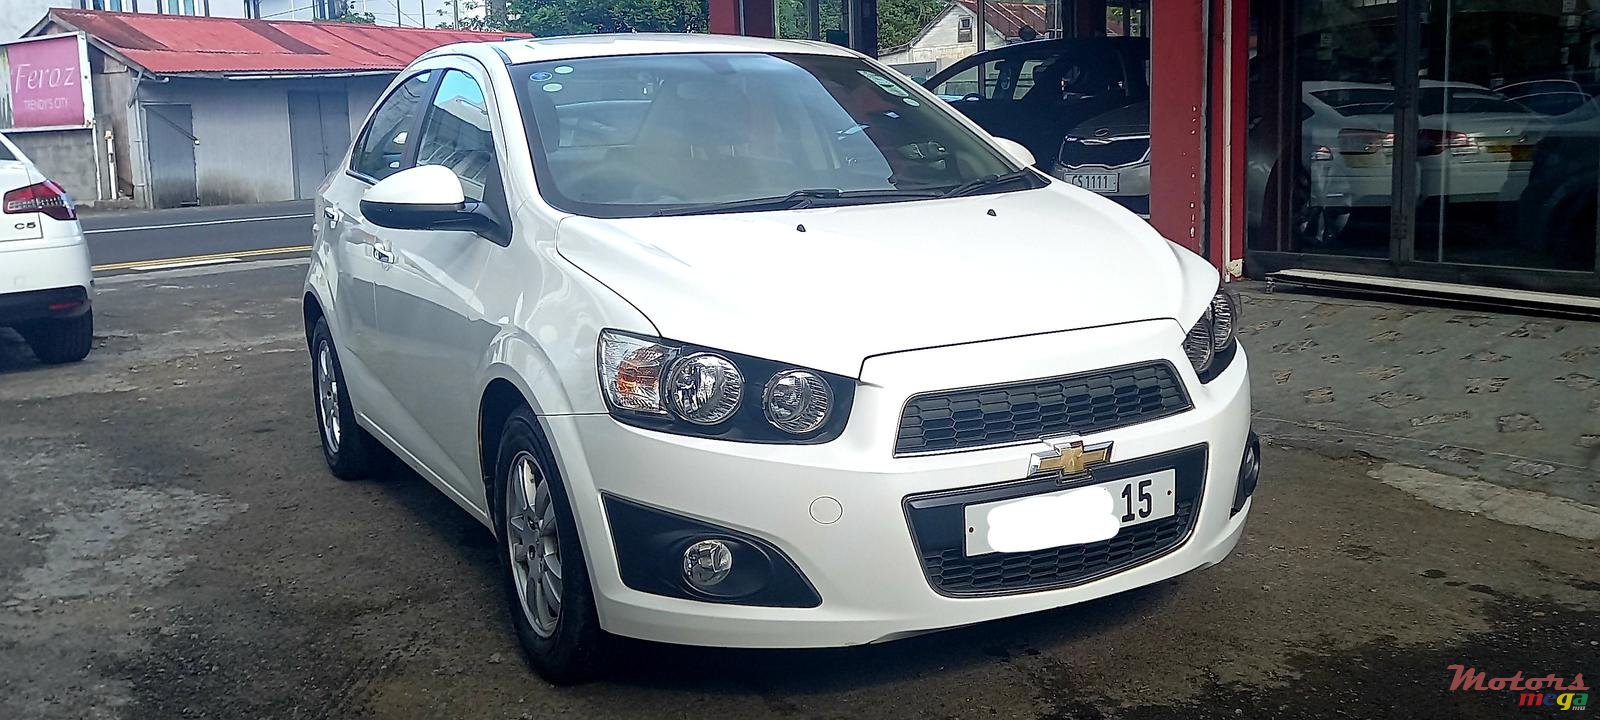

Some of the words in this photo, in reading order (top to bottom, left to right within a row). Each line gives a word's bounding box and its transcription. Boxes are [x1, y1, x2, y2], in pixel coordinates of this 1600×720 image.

[15, 63, 75, 93] Feroz
[14, 222, 36, 230] C5
[1120, 479, 1153, 523] 15
